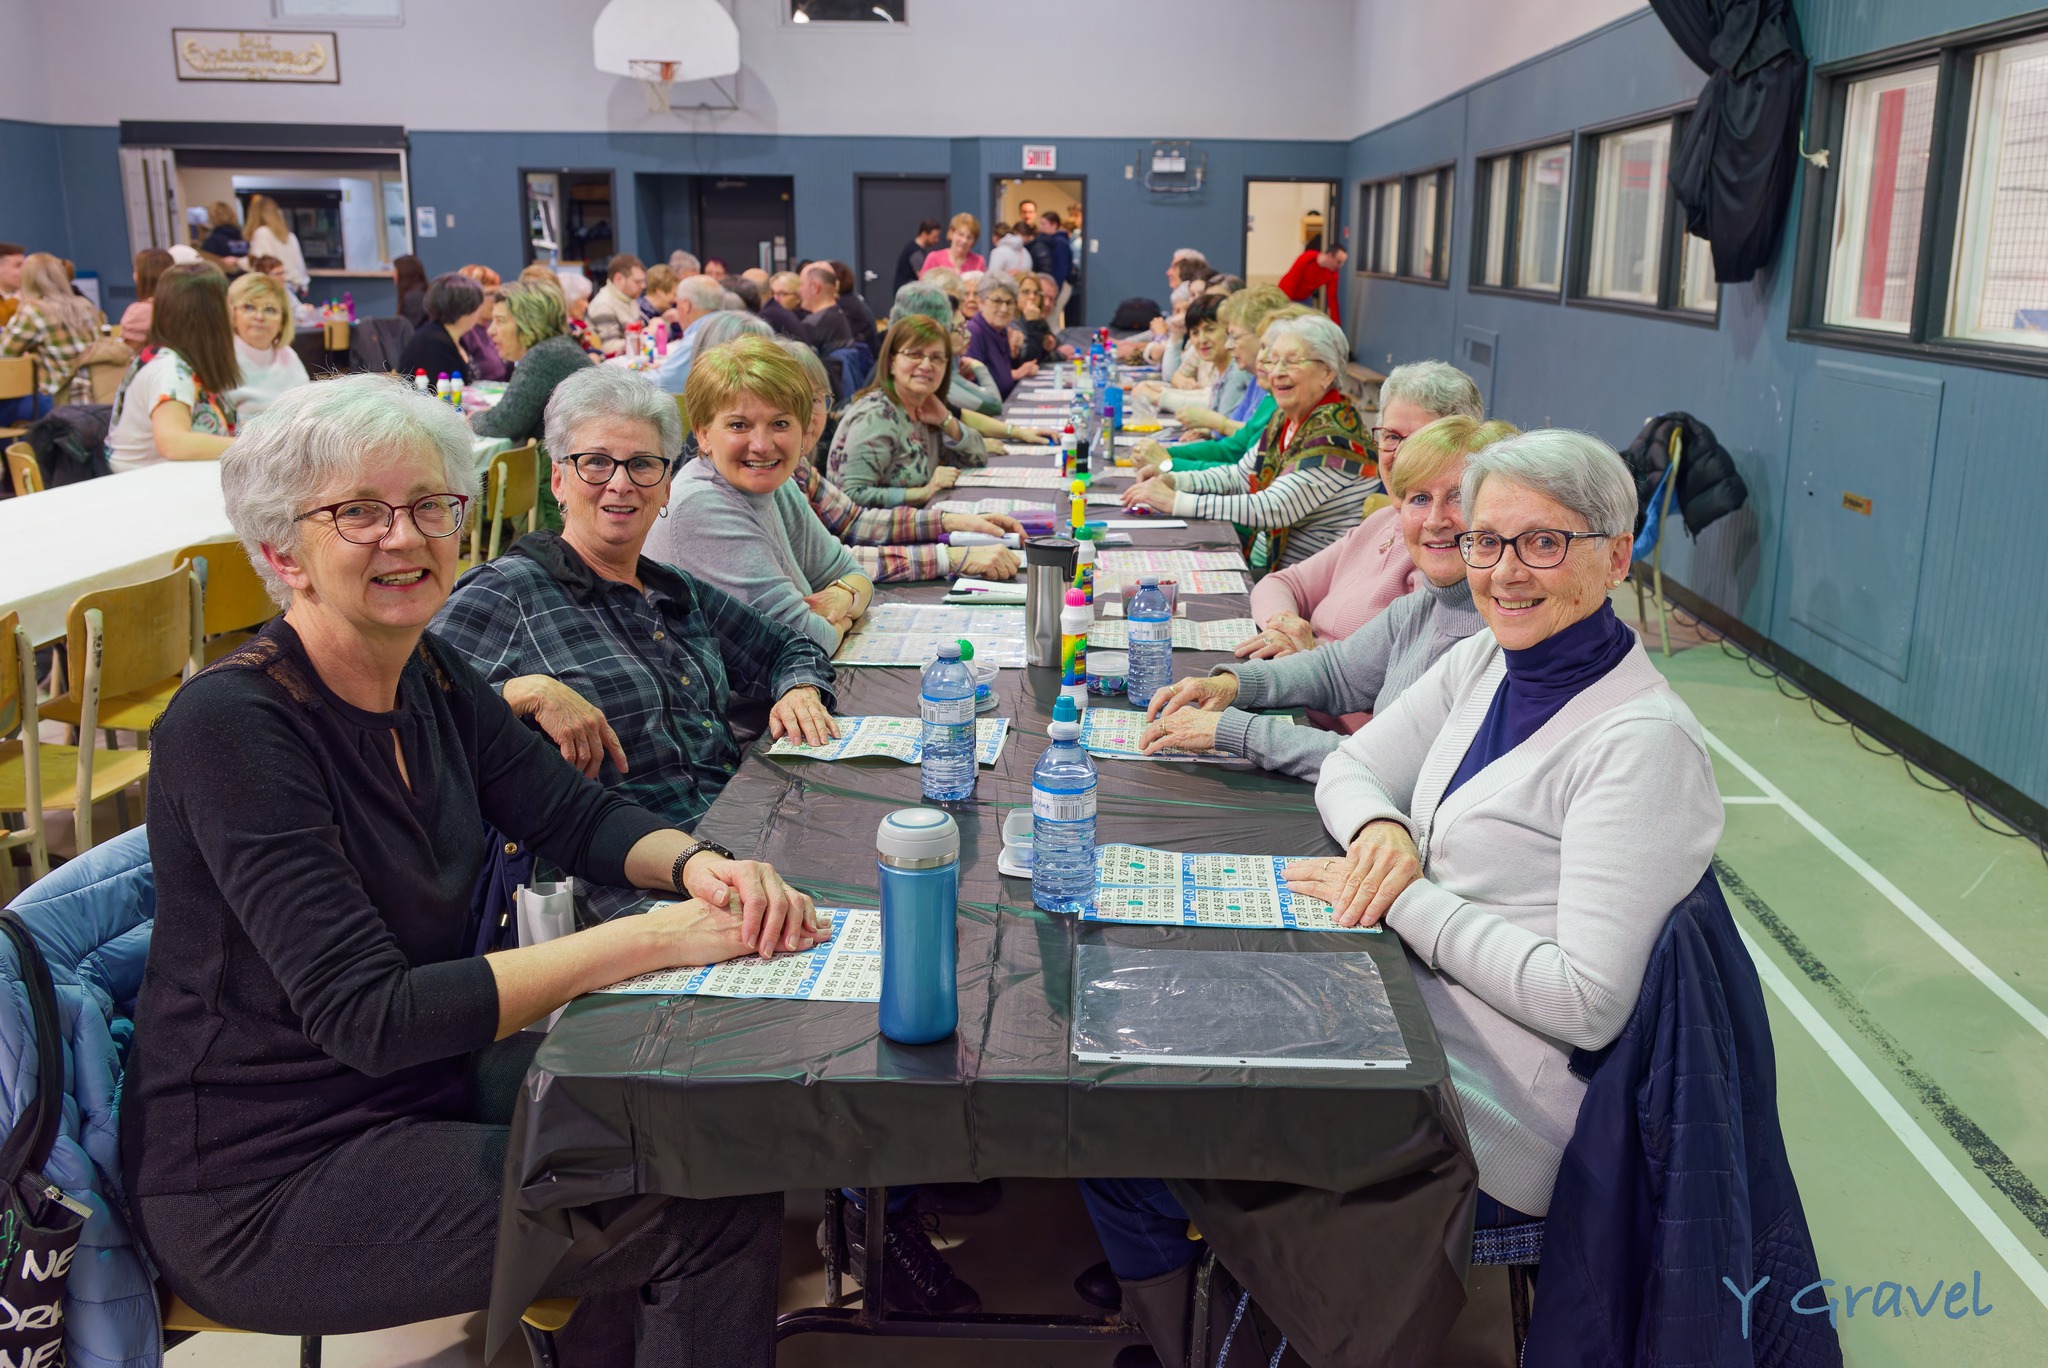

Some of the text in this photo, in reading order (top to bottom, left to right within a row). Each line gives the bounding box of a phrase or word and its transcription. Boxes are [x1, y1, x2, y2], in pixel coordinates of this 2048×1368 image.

[1183, 856, 1194, 885] BINGO
[1184, 889, 1195, 920] BINGO
[1279, 893, 1295, 925] BINGO
[798, 955, 826, 995] BINGO
